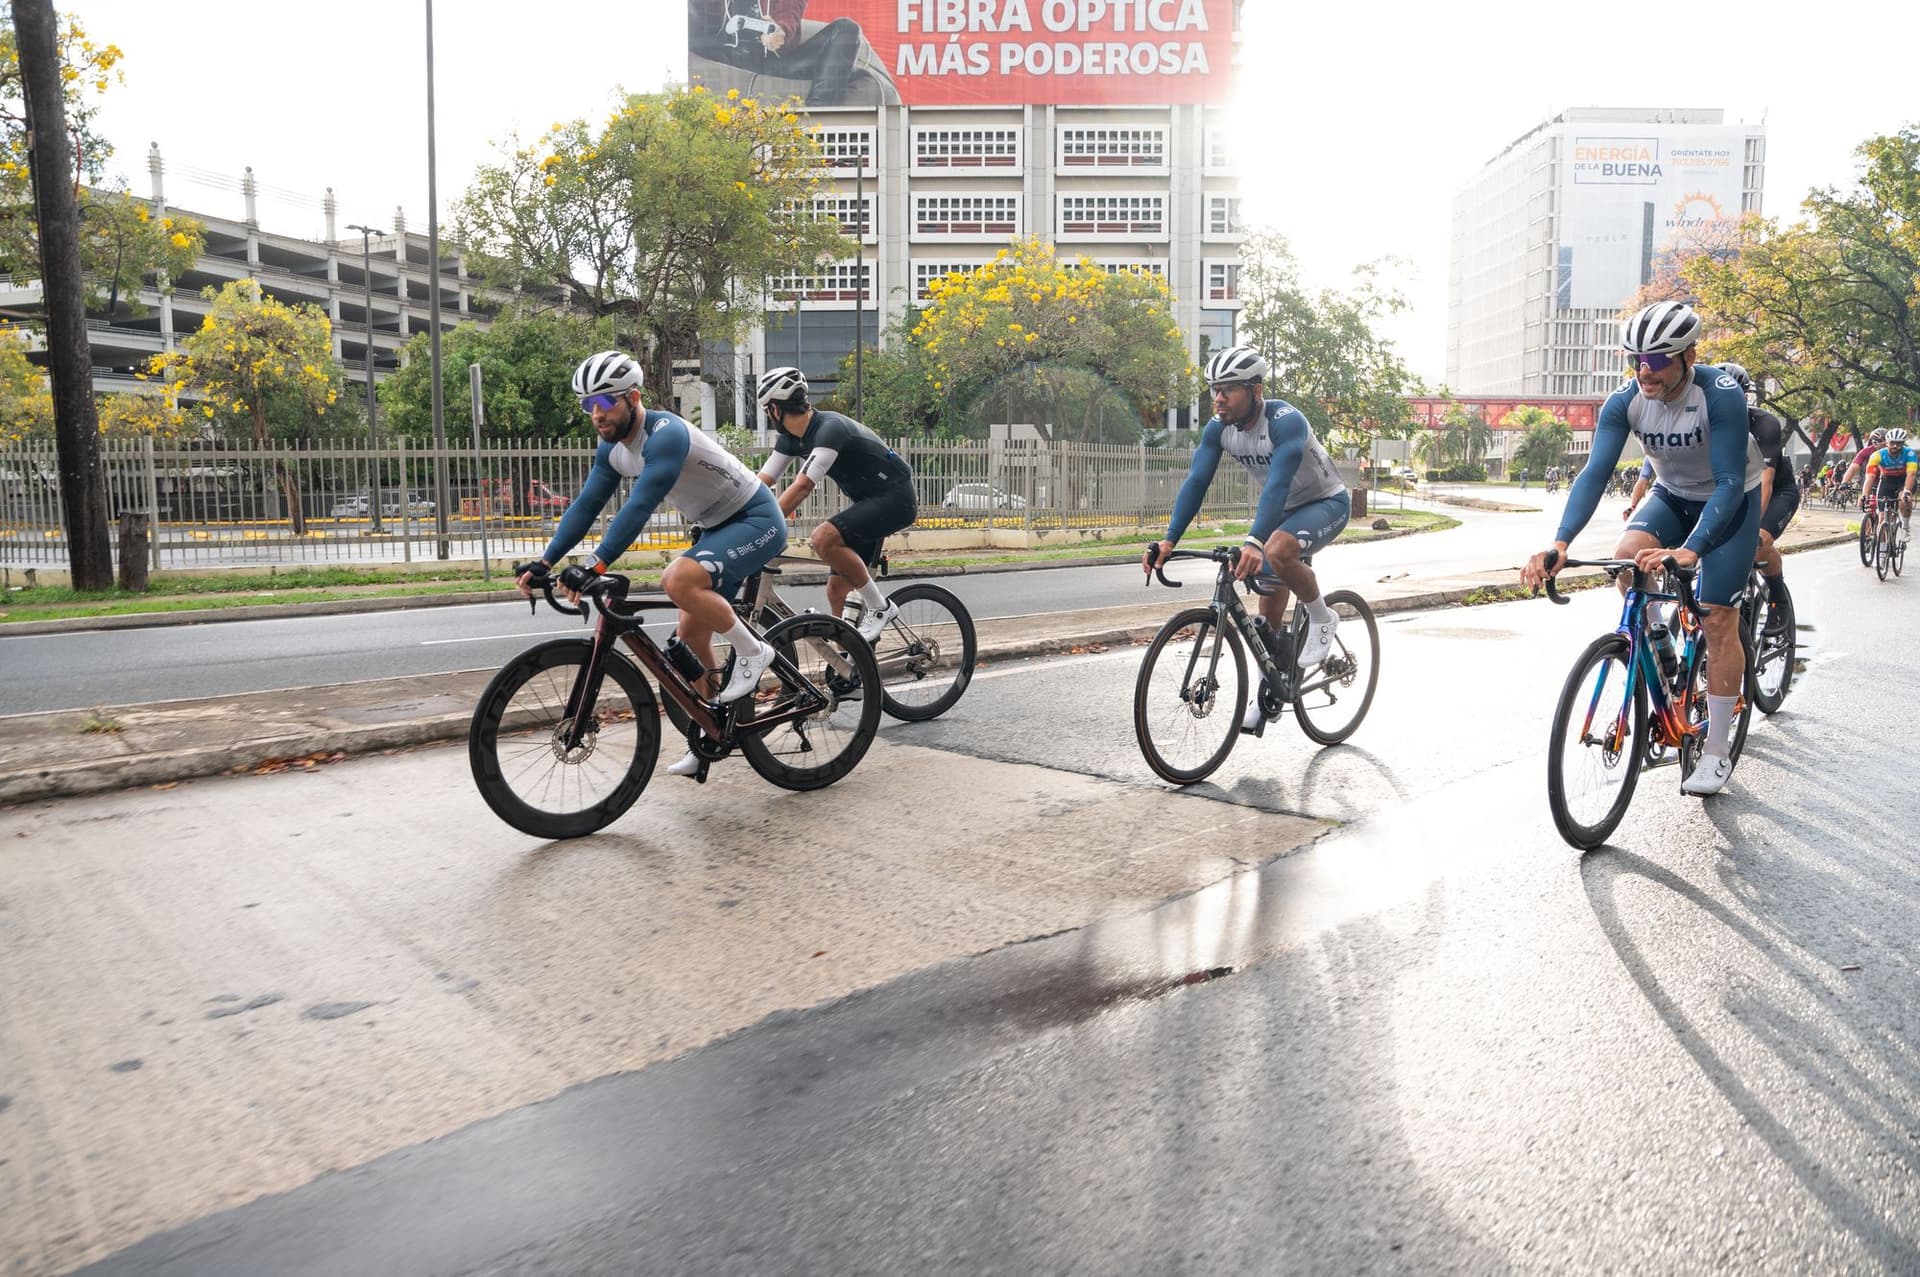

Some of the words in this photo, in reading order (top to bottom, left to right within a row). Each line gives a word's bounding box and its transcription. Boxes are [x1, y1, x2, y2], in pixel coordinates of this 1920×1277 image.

[897, 0, 1032, 33] FIBRA
[896, 34, 991, 76] MÁS
[999, 42, 1210, 75] PODEROSA
[1602, 163, 1663, 177] BUENA
